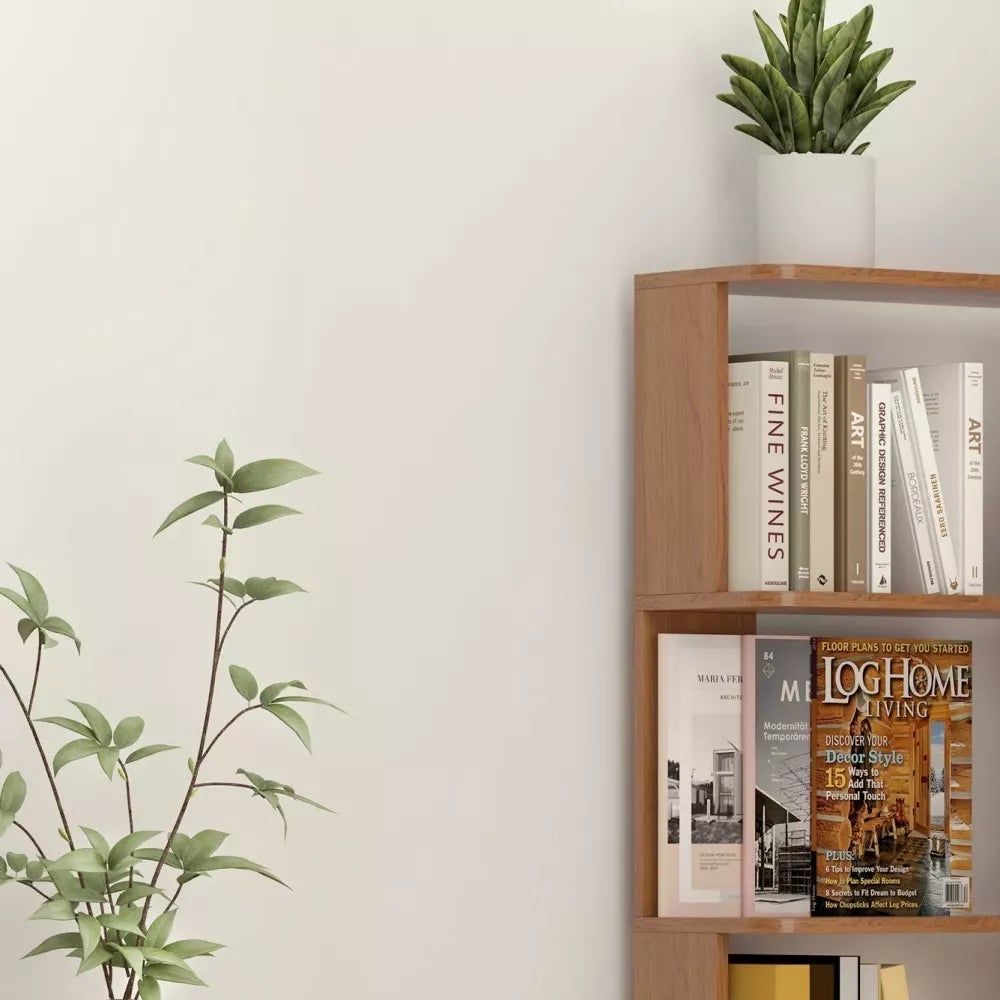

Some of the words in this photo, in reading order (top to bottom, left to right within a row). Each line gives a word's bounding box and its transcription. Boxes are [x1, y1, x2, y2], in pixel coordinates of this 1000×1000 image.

[768, 393, 784, 454] FINE
[851, 411, 865, 449] ART
[878, 402, 886, 446] GRAPHIC
[800, 426, 808, 454] FRANK
[968, 417, 982, 454] ART
[800, 454, 808, 481] LLOYD
[878, 449, 886, 485] DESIGN
[800, 482, 808, 515] WRIGHT
[907, 472, 924, 525] BORDEAUX
[930, 473, 944, 515] SAARINEN
[768, 468, 784, 560] WINES
[878, 488, 886, 553] REFERENCED
[938, 516, 948, 538] EERO
[822, 641, 849, 652] FLOOR
[852, 641, 879, 652] PLANS
[882, 642, 892, 653] TO
[895, 643, 911, 653] GET
[913, 643, 930, 653] YOU
[932, 644, 969, 654] STARTED
[697, 675, 724, 683] MARIA
[866, 700, 929, 718] LIVING
[825, 735, 865, 746] DISCOVER
[867, 735, 888, 746] YOUR
[825, 750, 865, 764] Decor
[868, 750, 904, 767] Style
[825, 767, 847, 788] 15
[848, 767, 868, 778] Ways
[871, 767, 879, 777] to
[848, 779, 864, 789] Add
[866, 779, 884, 788] That
[826, 790, 860, 801] Personal
[863, 790, 886, 801] Touch
[826, 850, 855, 861] PLUS:
[831, 865, 843, 873] Tips
[889, 865, 910, 874] Design
[860, 877, 880, 886] Special
[897, 889, 917, 897] Budget
[840, 901, 869, 909] Chopsticks
[889, 901, 900, 909] Log
